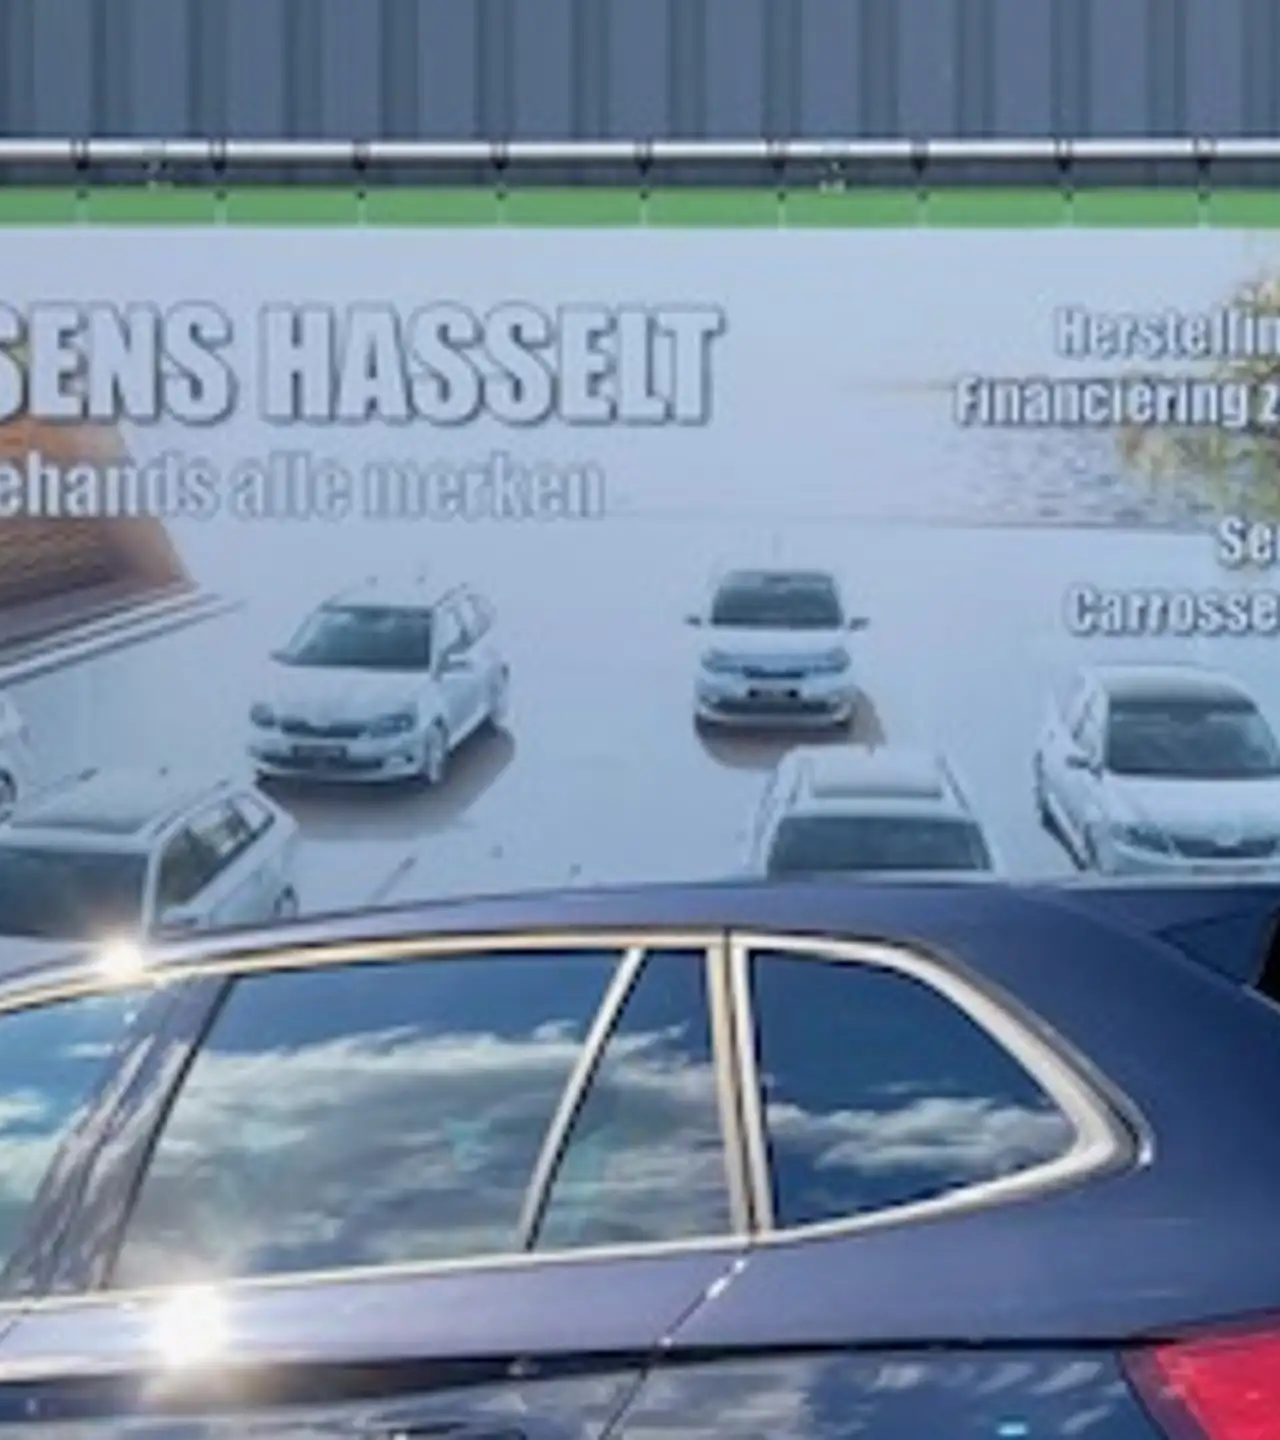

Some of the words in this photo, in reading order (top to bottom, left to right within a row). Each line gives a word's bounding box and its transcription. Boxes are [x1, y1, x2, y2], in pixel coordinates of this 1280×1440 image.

[260, 300, 726, 427] HASSELT
[954, 376, 1249, 428] Financiering
[233, 450, 352, 520] alle
[362, 450, 608, 520] merken
